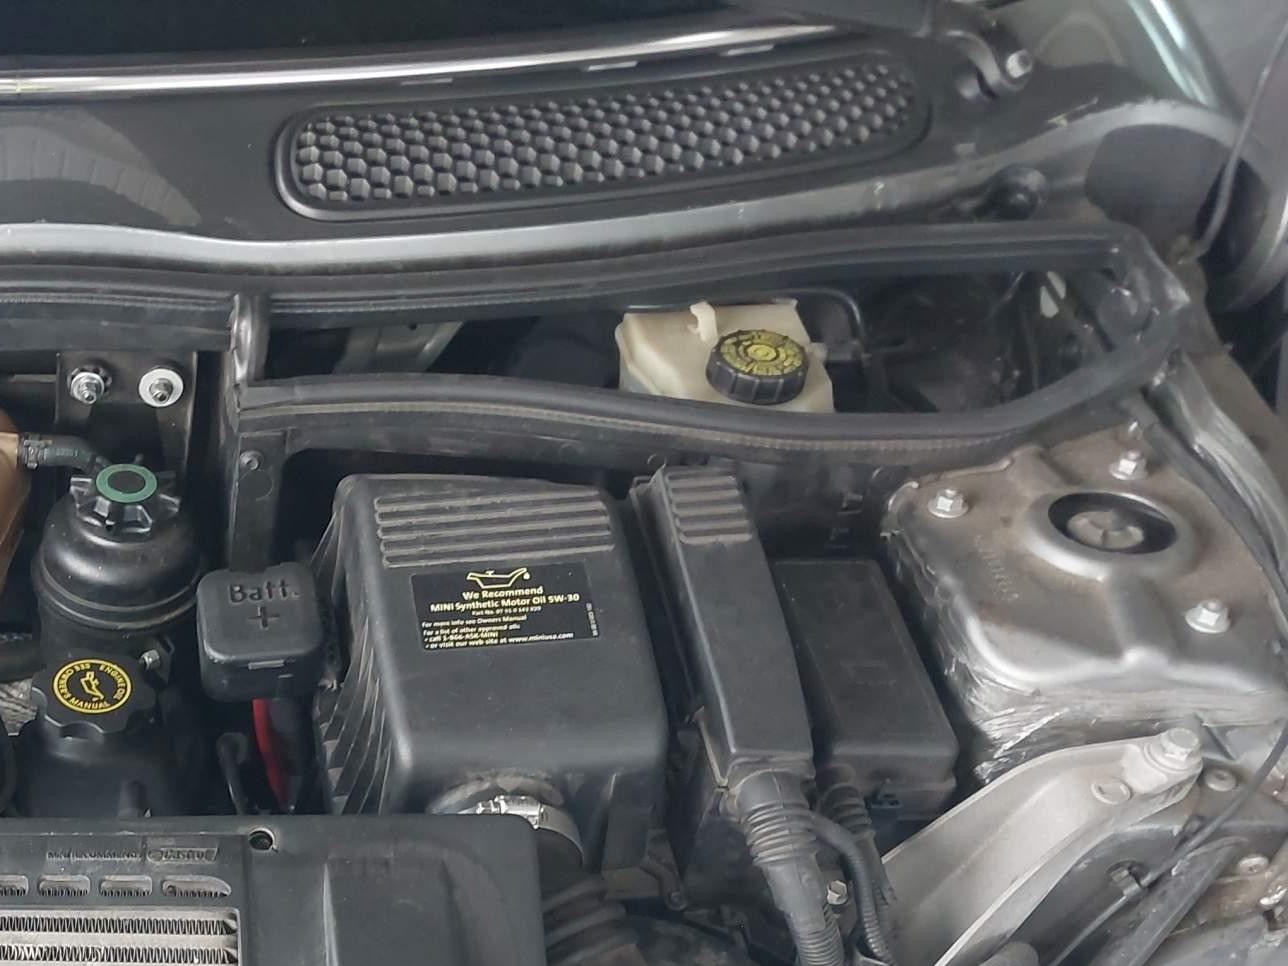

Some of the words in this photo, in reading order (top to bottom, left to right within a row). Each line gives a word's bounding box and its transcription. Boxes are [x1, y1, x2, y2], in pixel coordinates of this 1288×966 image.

[462, 591, 480, 600] We
[482, 586, 543, 598] Recommend
[430, 603, 454, 612] MINI
[455, 600, 500, 612] Synthetic
[501, 599, 531, 607] Motor
[532, 596, 546, 605] Oil
[548, 593, 580, 604] 5W-30
[70, 697, 111, 709] MANUAL
